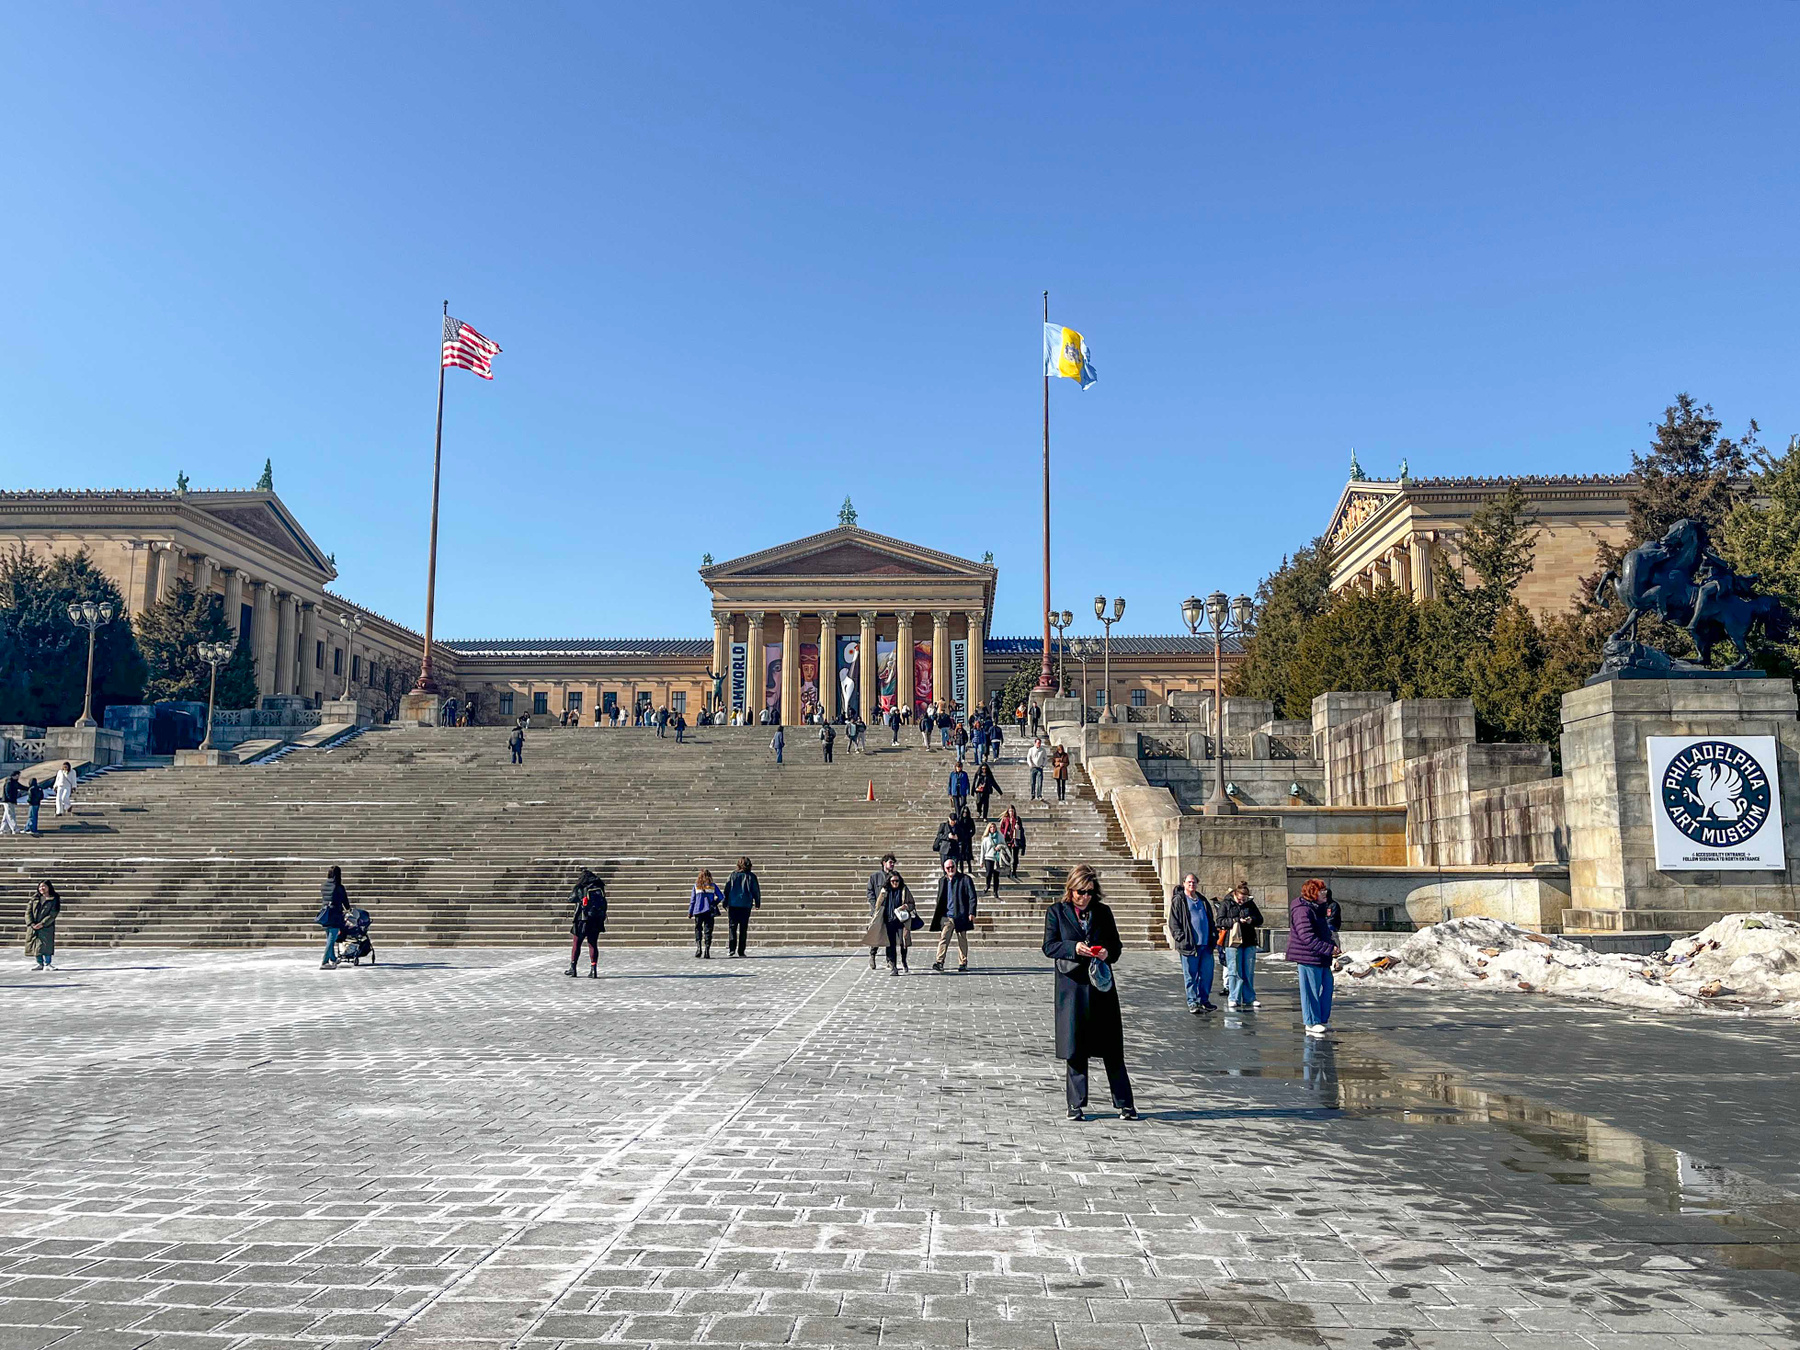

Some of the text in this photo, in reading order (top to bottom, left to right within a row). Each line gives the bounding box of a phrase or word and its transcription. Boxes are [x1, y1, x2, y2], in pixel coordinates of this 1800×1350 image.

[954, 643, 965, 701] SURREALISM
[1666, 745, 1765, 790] PHILADELPHIA
[1670, 804, 1766, 844] ART MUSEUM
